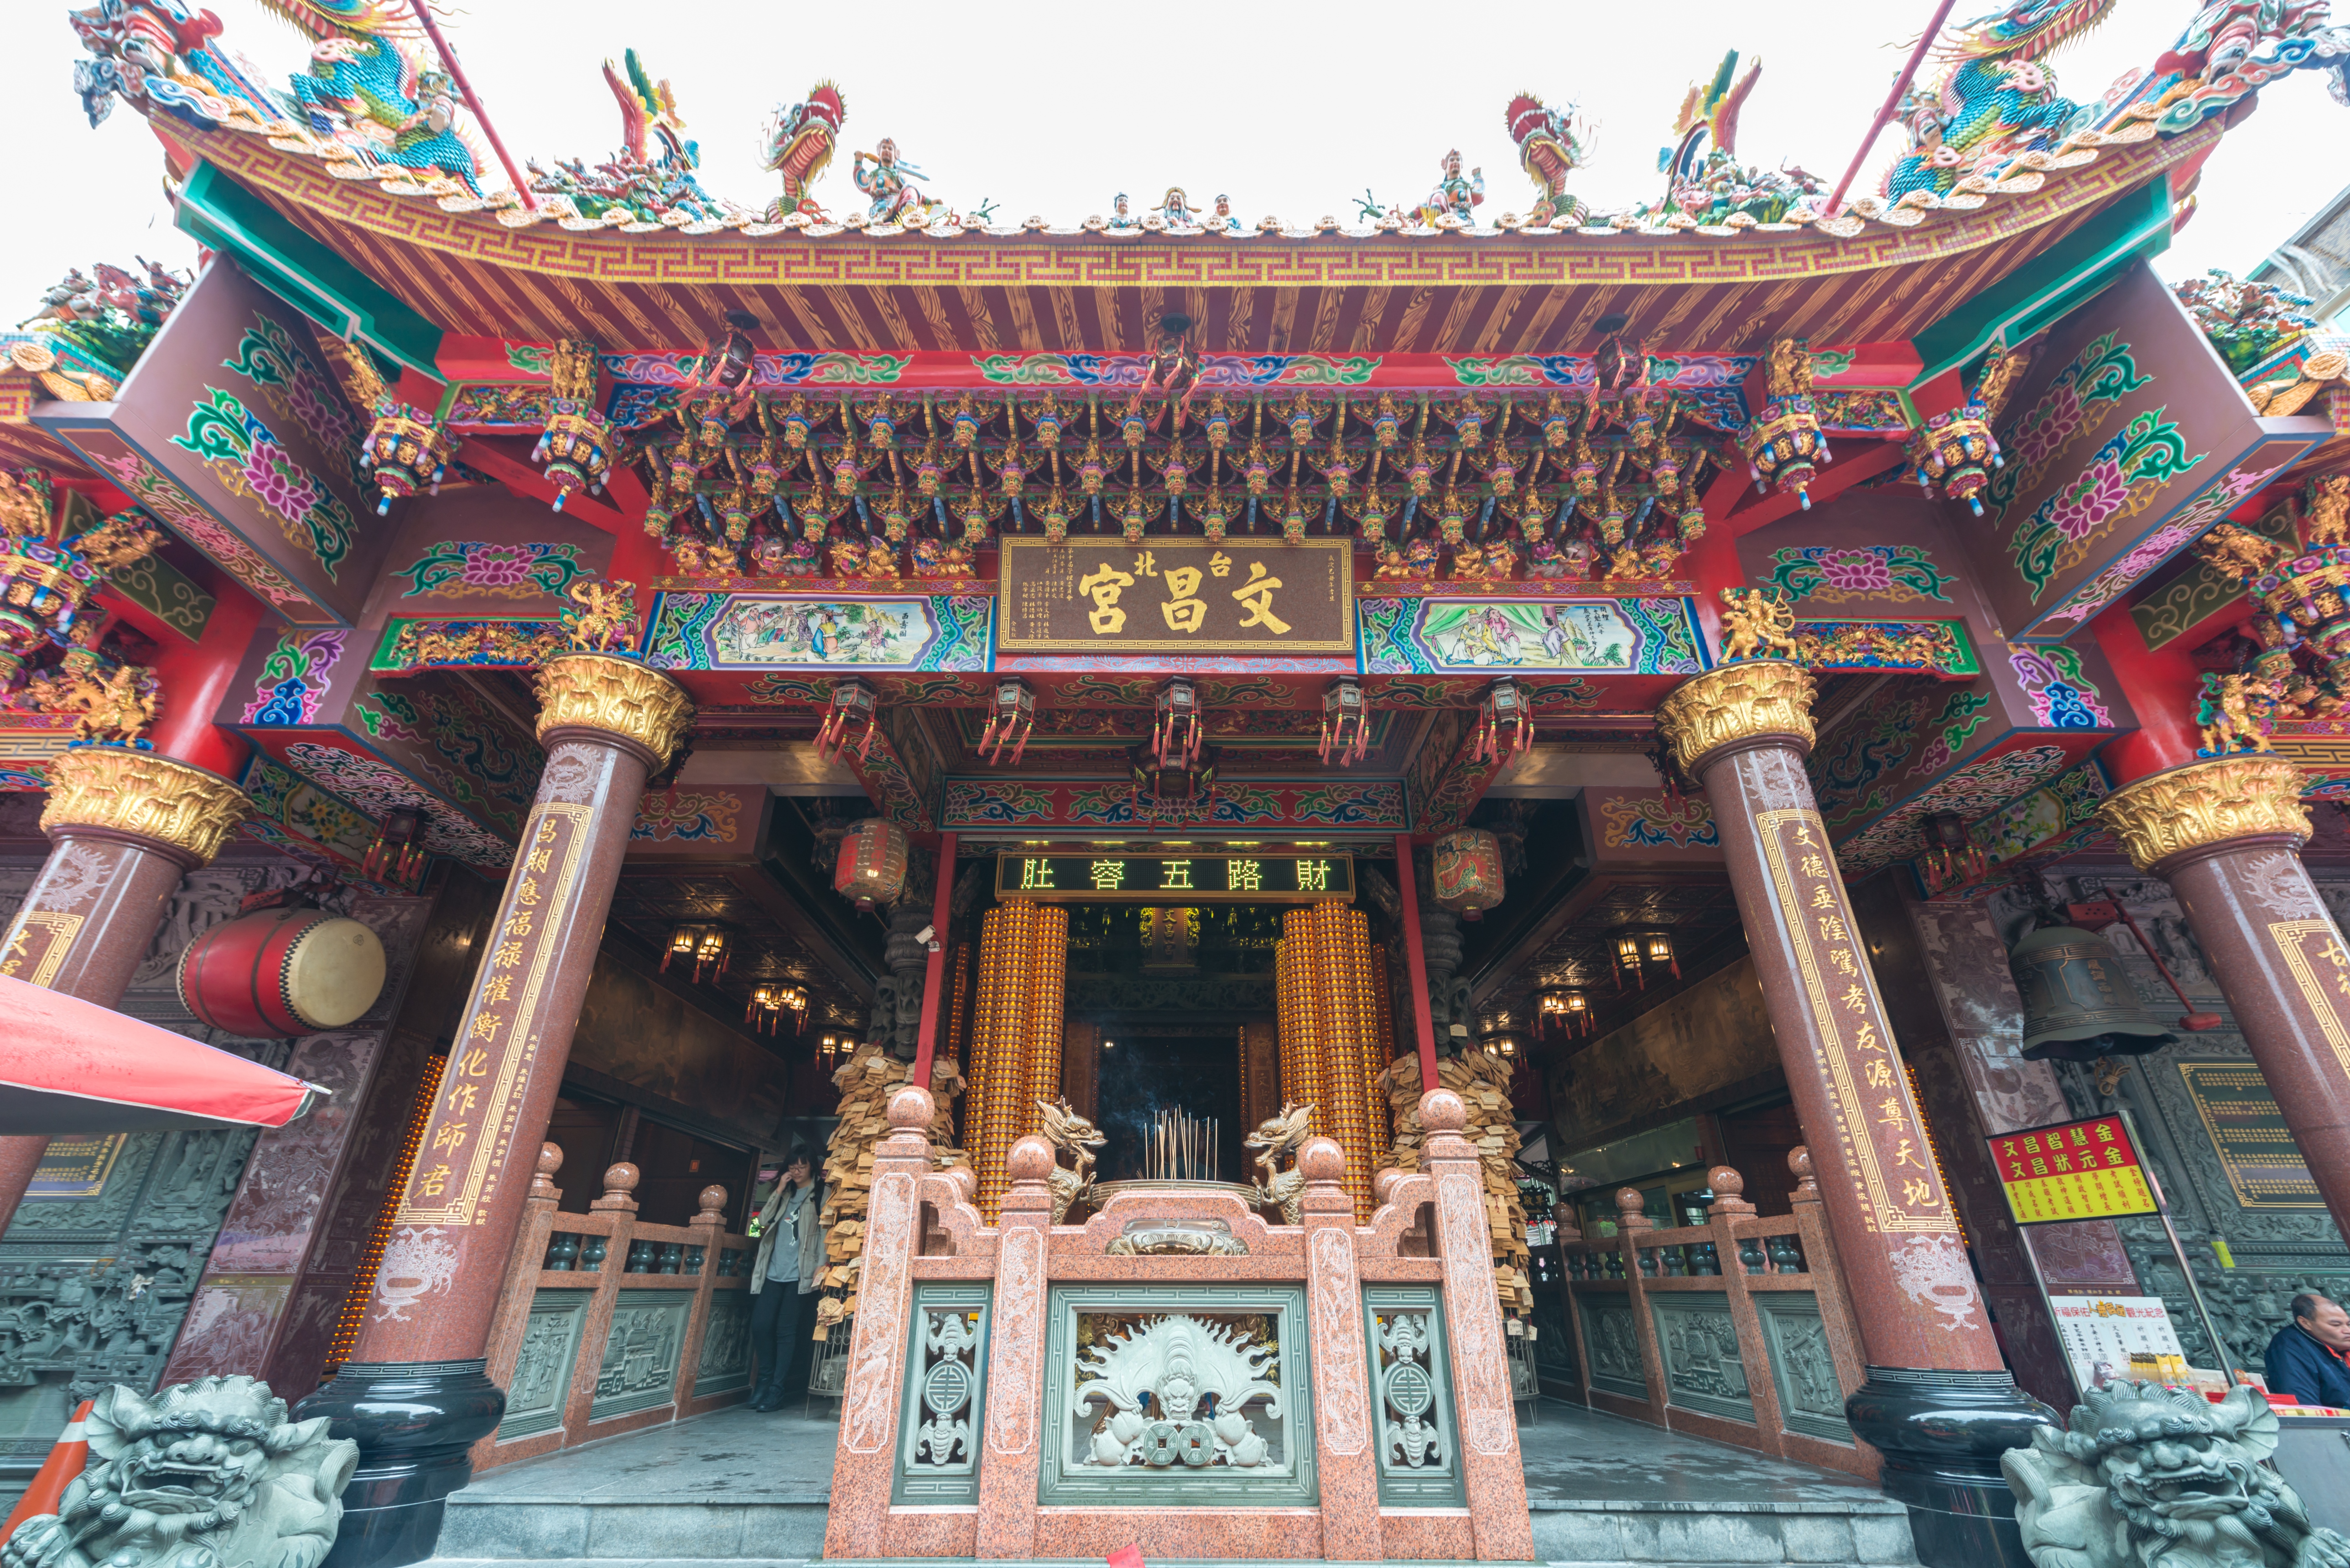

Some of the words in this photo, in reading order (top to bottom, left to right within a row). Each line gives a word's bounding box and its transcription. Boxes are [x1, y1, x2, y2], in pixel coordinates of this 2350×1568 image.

[1134, 551, 1232, 577] 台北
[1079, 561, 1292, 634] 文昌宮
[1163, 909, 1177, 955] 文昌宮
[2002, 1123, 2115, 1158] 文昌智慧金
[2010, 1146, 2125, 1178] 文昌狀元金
[2010, 1183, 2028, 1219] 事業亨通
[2025, 1181, 2043, 1217] 功成名就
[2041, 1179, 2059, 1215] 求職考試
[2074, 1174, 2094, 1213] 開啟智慧
[2092, 1172, 2112, 1211] 學問增長
[2110, 1170, 2131, 1210] 考試順利
[2129, 1167, 2150, 1208] 金榜題名
[2125, 1307, 2165, 1318] 觀光紀念
